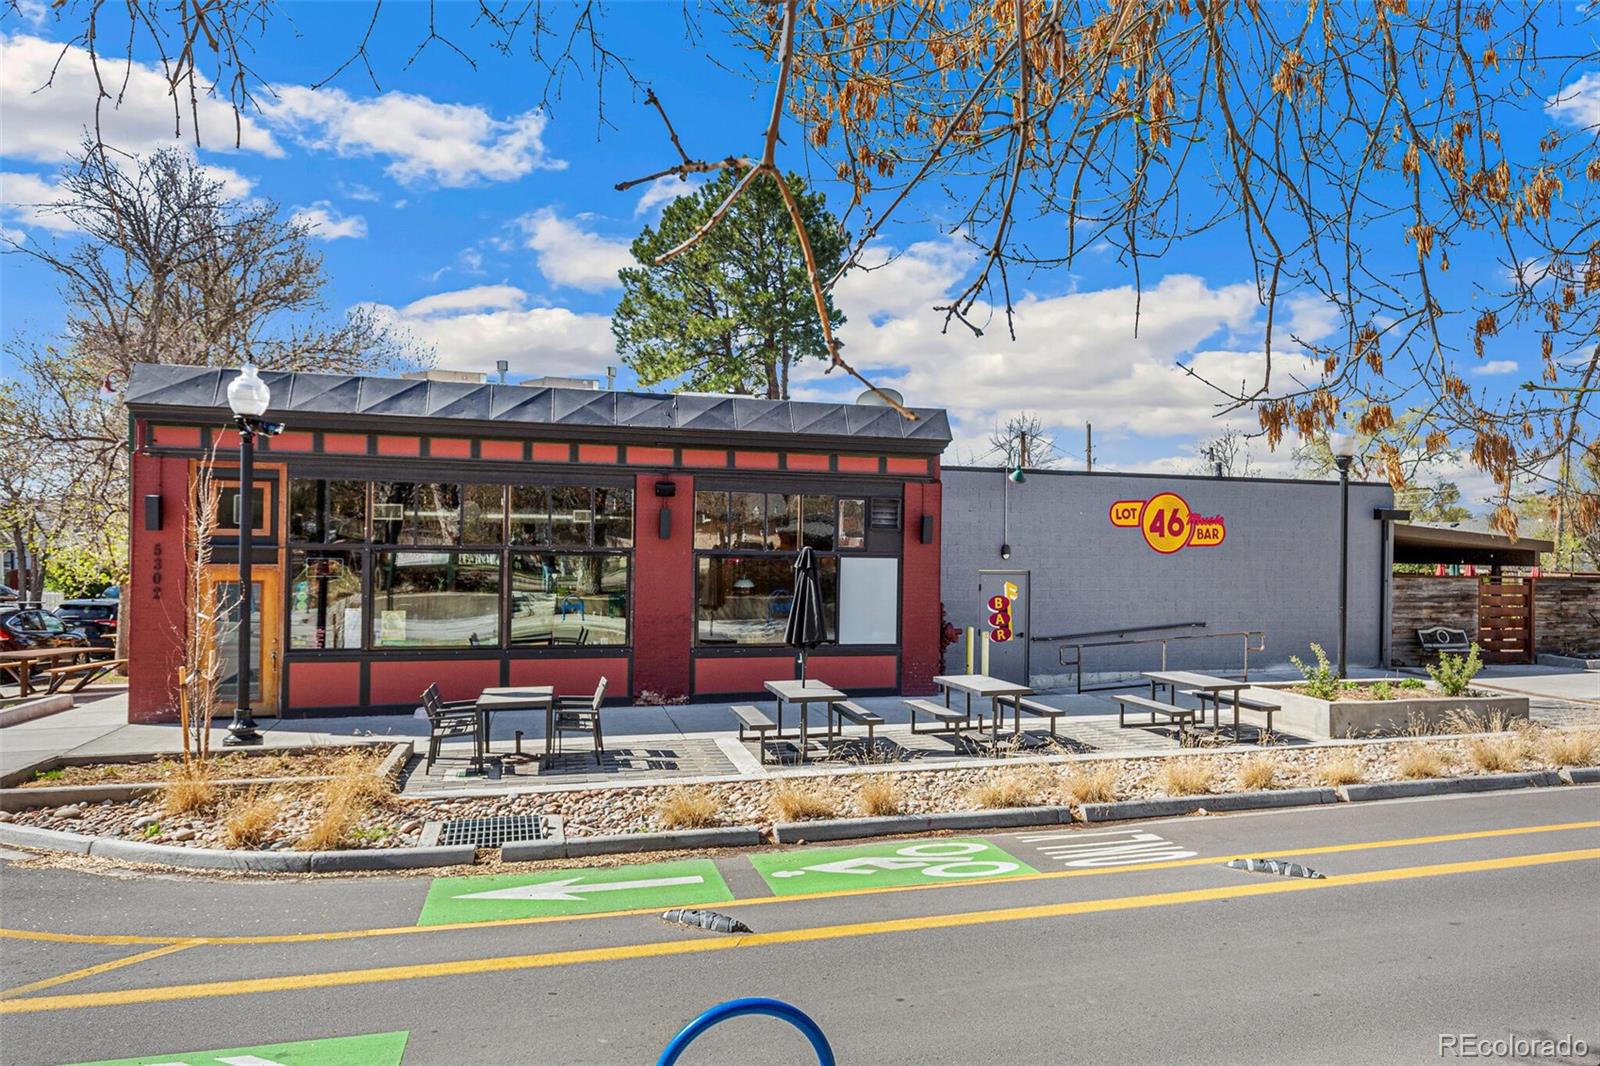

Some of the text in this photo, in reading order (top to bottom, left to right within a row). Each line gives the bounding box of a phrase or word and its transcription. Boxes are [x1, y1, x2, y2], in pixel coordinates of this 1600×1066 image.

[1115, 508, 1185, 538] LOT 46
[1196, 528, 1220, 540] BAR
[152, 543, 163, 600] 5302
[993, 597, 1007, 641] BAR
[1015, 829, 1199, 867] ONLY
